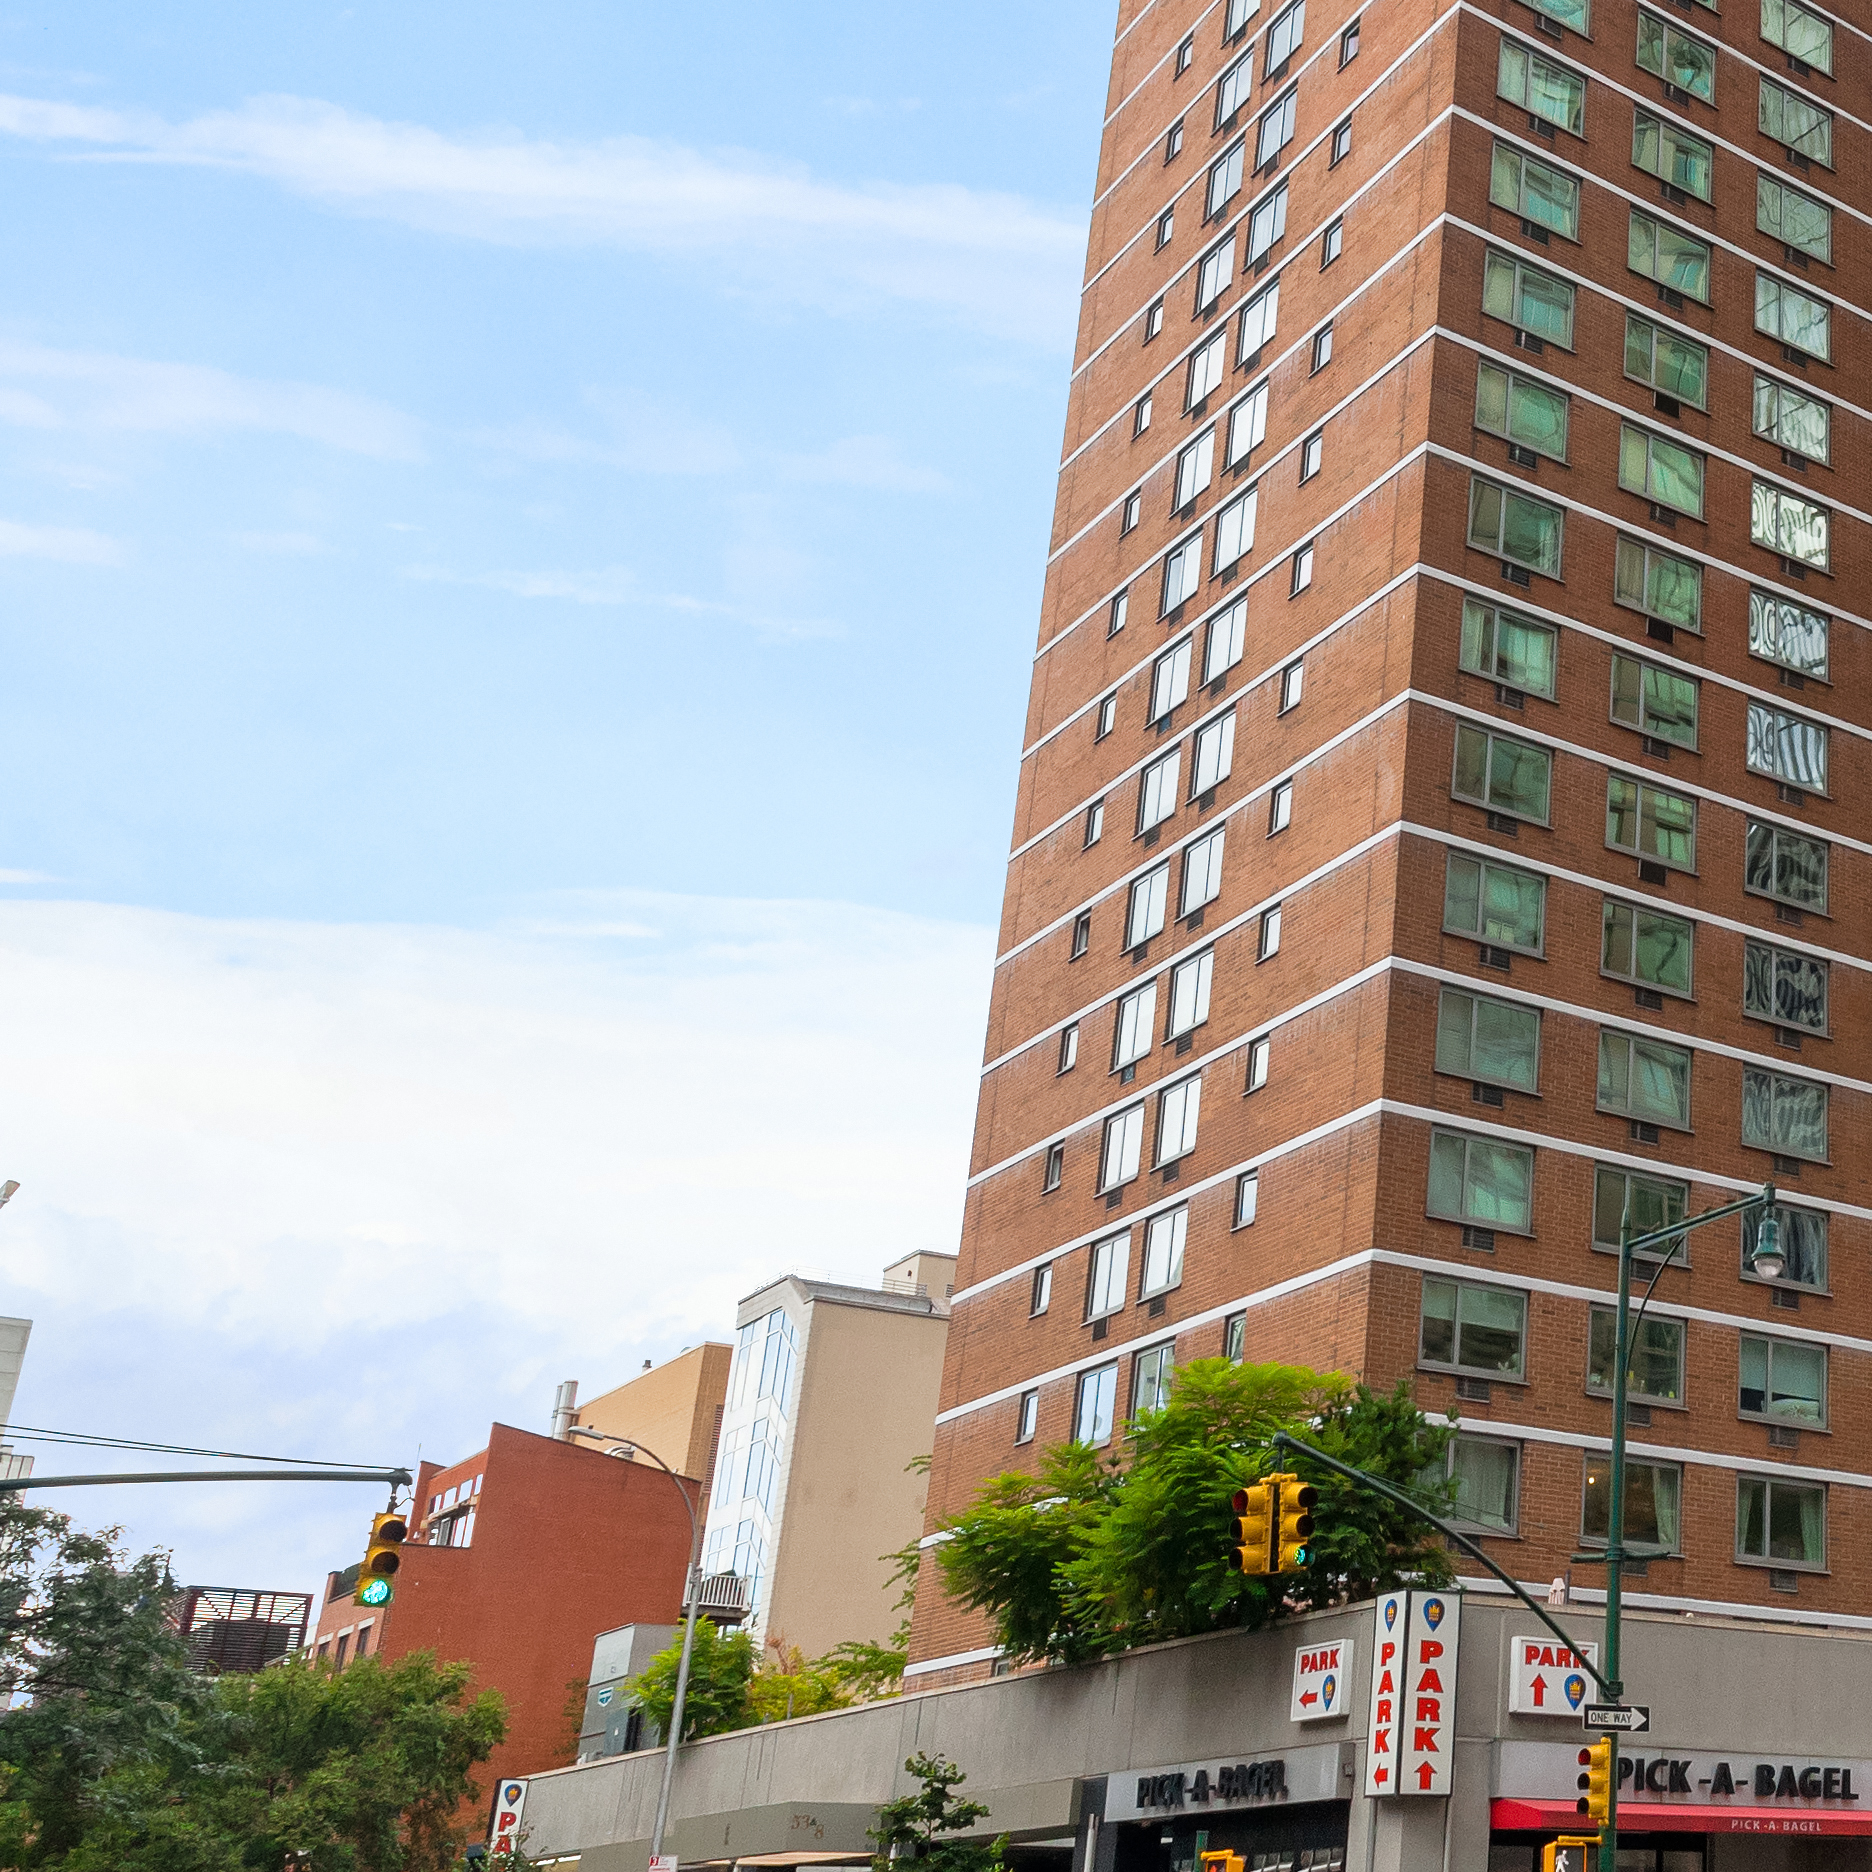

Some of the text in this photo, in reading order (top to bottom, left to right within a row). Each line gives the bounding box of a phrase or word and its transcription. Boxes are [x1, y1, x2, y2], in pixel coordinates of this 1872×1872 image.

[1300, 1648, 1340, 1675] PARK
[1374, 1642, 1395, 1755] PARK
[1413, 1639, 1444, 1753] PARK
[1590, 1712, 1632, 1724] ONE WAY
[1617, 1757, 1692, 1793] PICK
[1755, 1764, 1859, 1800] BAGEL
[1731, 1819, 1760, 1830] PICK
[1783, 1820, 1822, 1832] BAGEL
